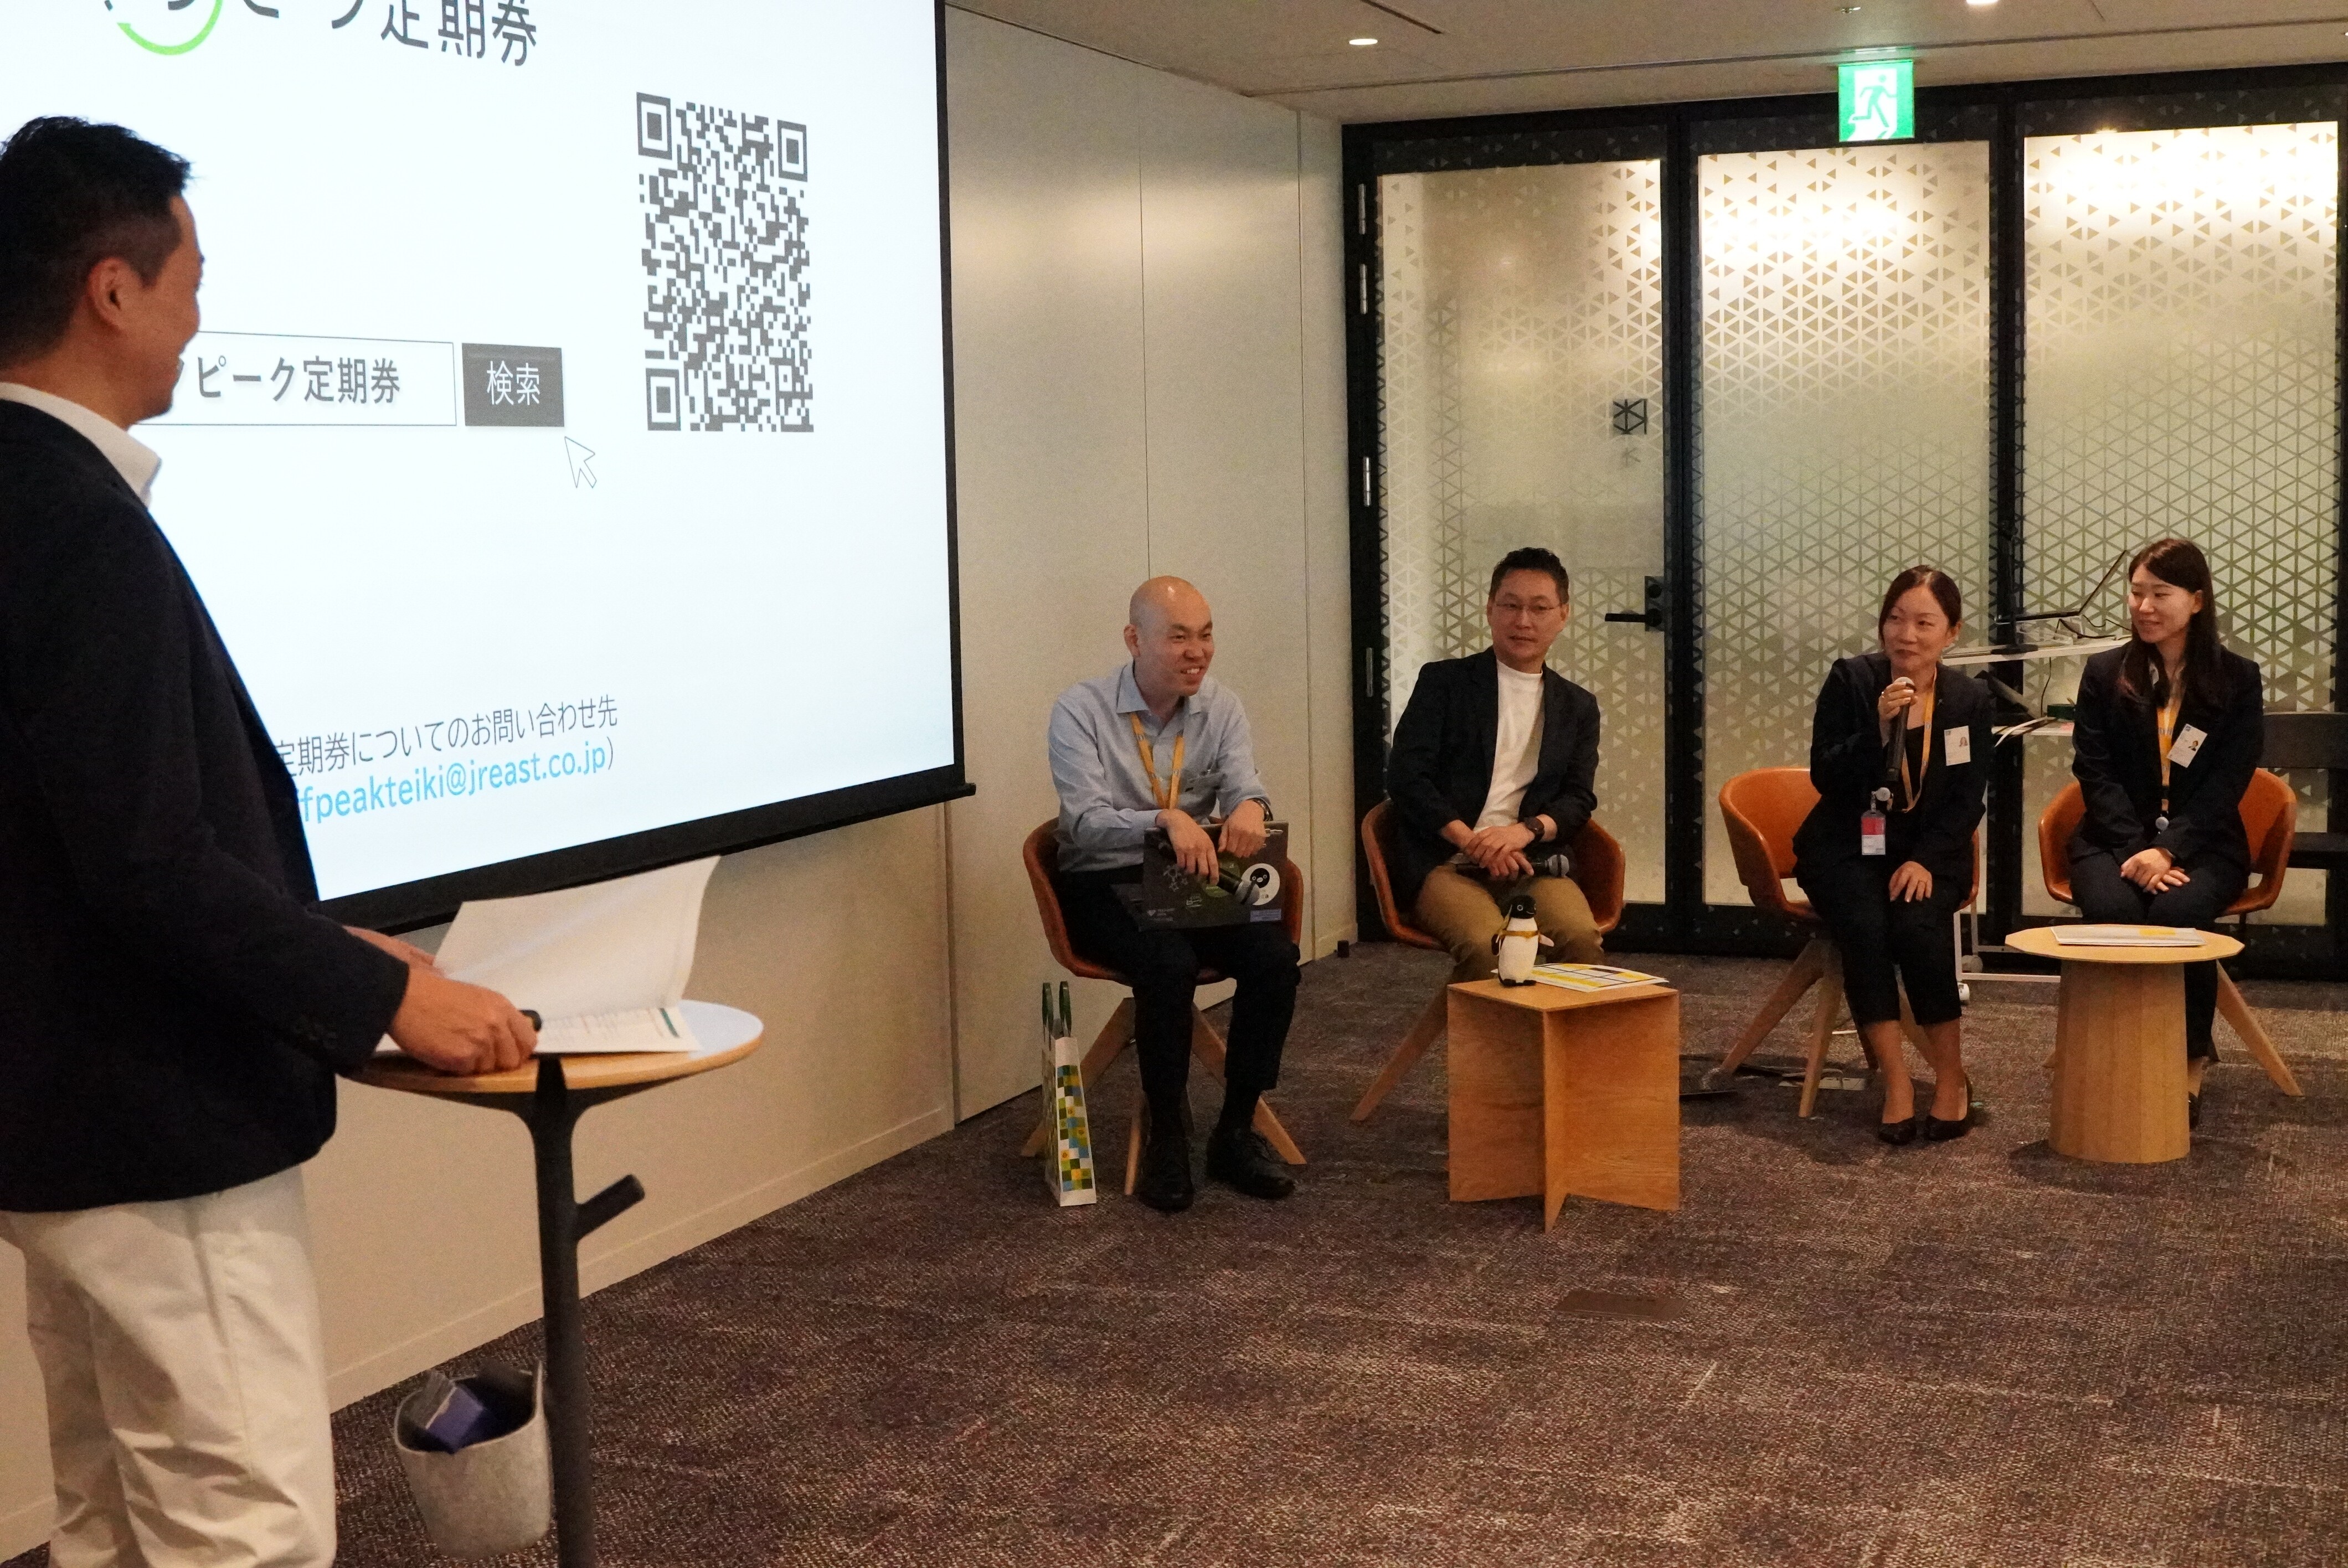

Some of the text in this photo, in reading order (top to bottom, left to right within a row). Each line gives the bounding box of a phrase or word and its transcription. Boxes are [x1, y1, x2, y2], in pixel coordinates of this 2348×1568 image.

[177, 354, 400, 404] ピーク定期券
[487, 360, 540, 406] 検索
[297, 736, 613, 824] fpeakteiki@jreast.co.jp)
